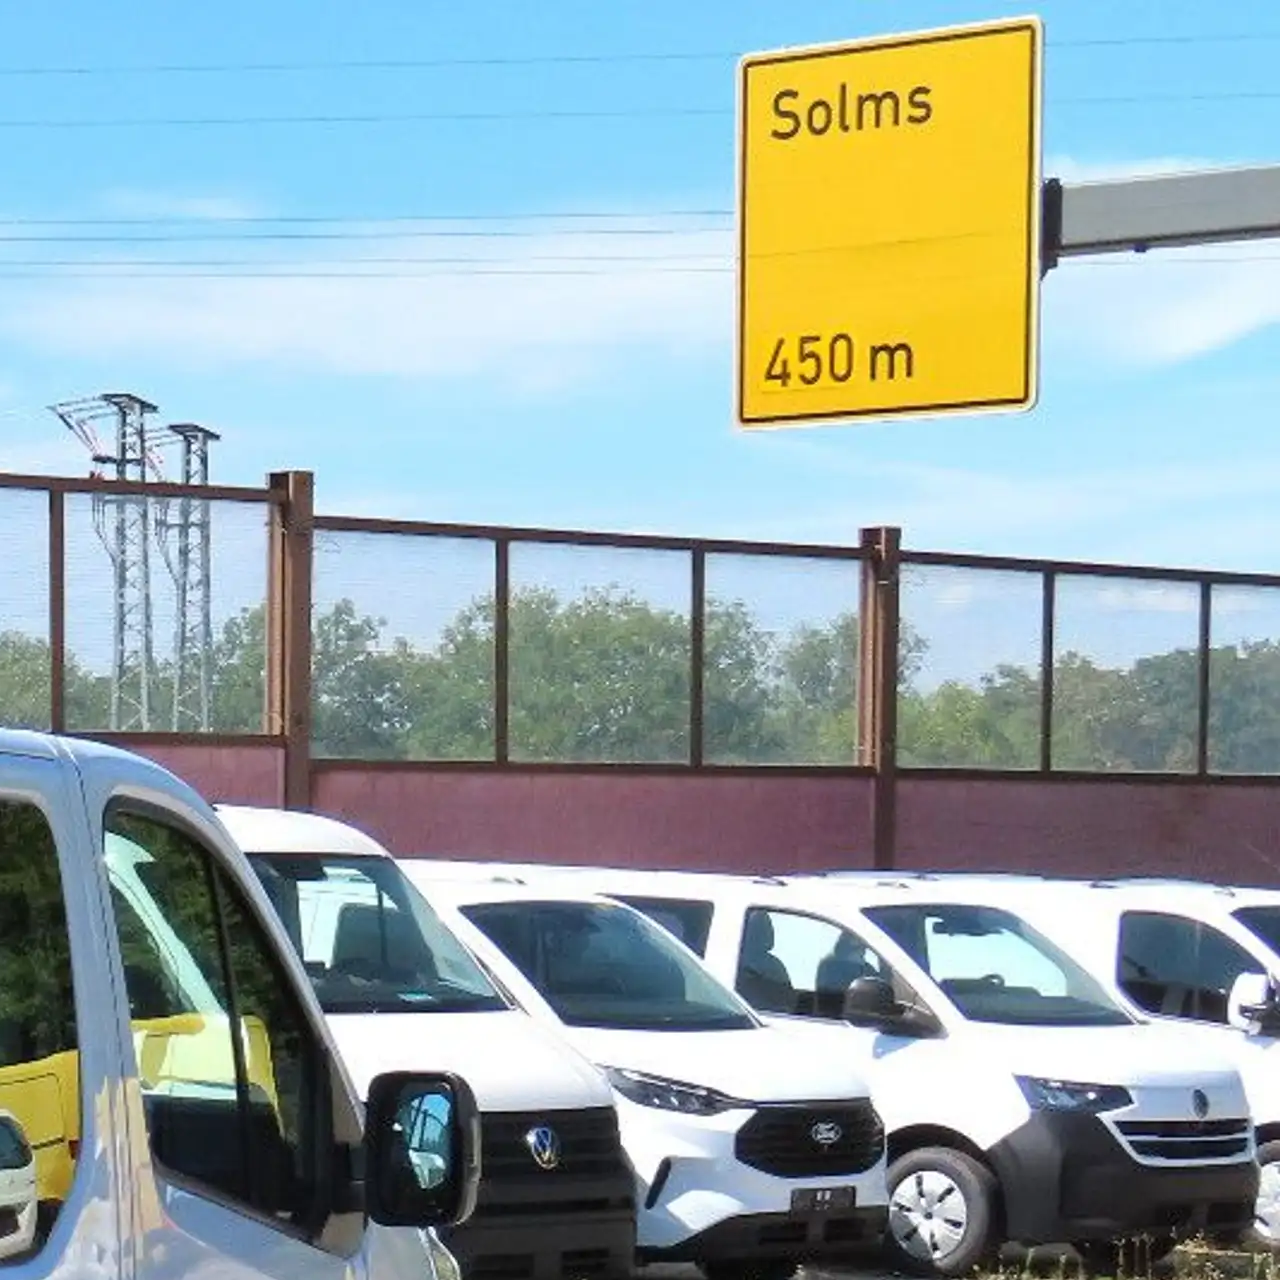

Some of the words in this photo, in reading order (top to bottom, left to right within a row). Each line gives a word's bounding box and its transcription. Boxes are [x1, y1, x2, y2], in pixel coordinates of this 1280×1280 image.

[771, 83, 933, 140] Solms
[764, 333, 854, 387] 450
[870, 341, 914, 381] m
